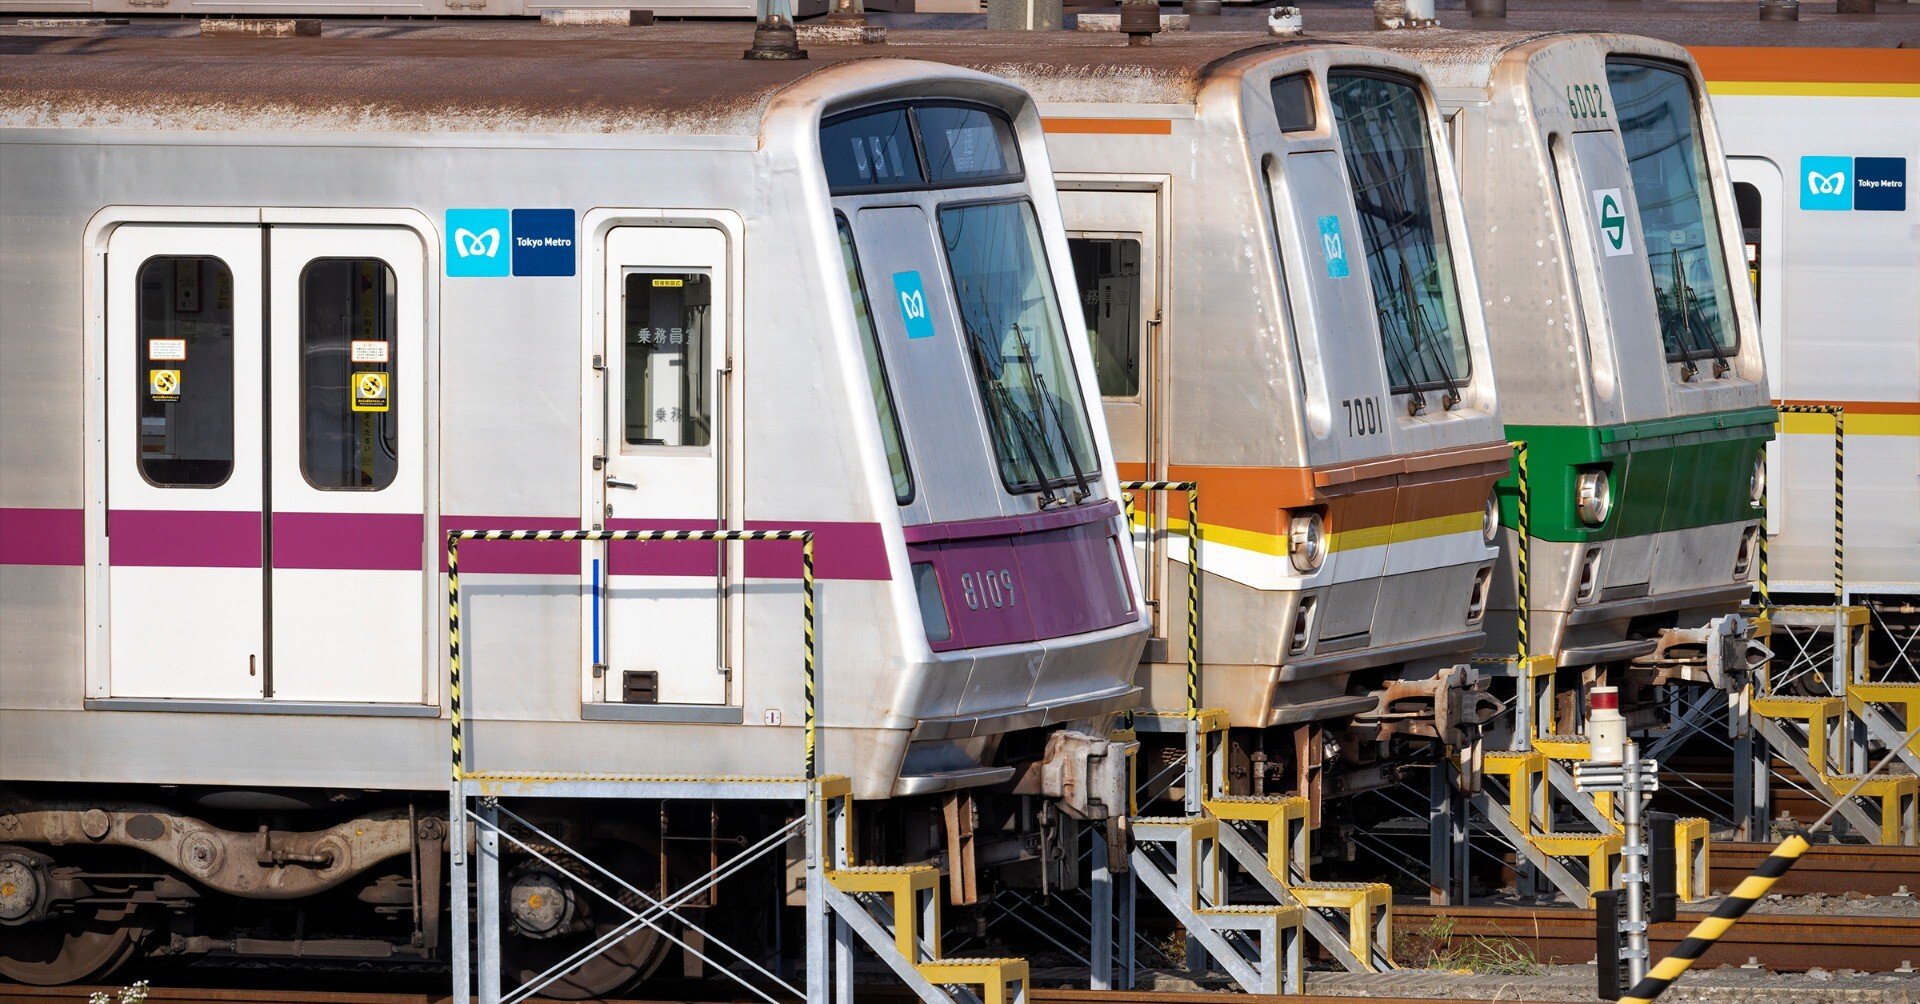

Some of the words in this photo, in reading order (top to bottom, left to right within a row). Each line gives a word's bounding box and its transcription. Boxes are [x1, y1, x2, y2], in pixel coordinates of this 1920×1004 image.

[1567, 84, 1607, 119] 6002
[1858, 179, 1879, 189] Tokyo
[1881, 179, 1903, 188] Metro
[516, 237, 543, 248] Tokyo
[544, 237, 572, 247] Metro
[1342, 396, 1383, 437] 7001
[962, 568, 1015, 611] 8109
